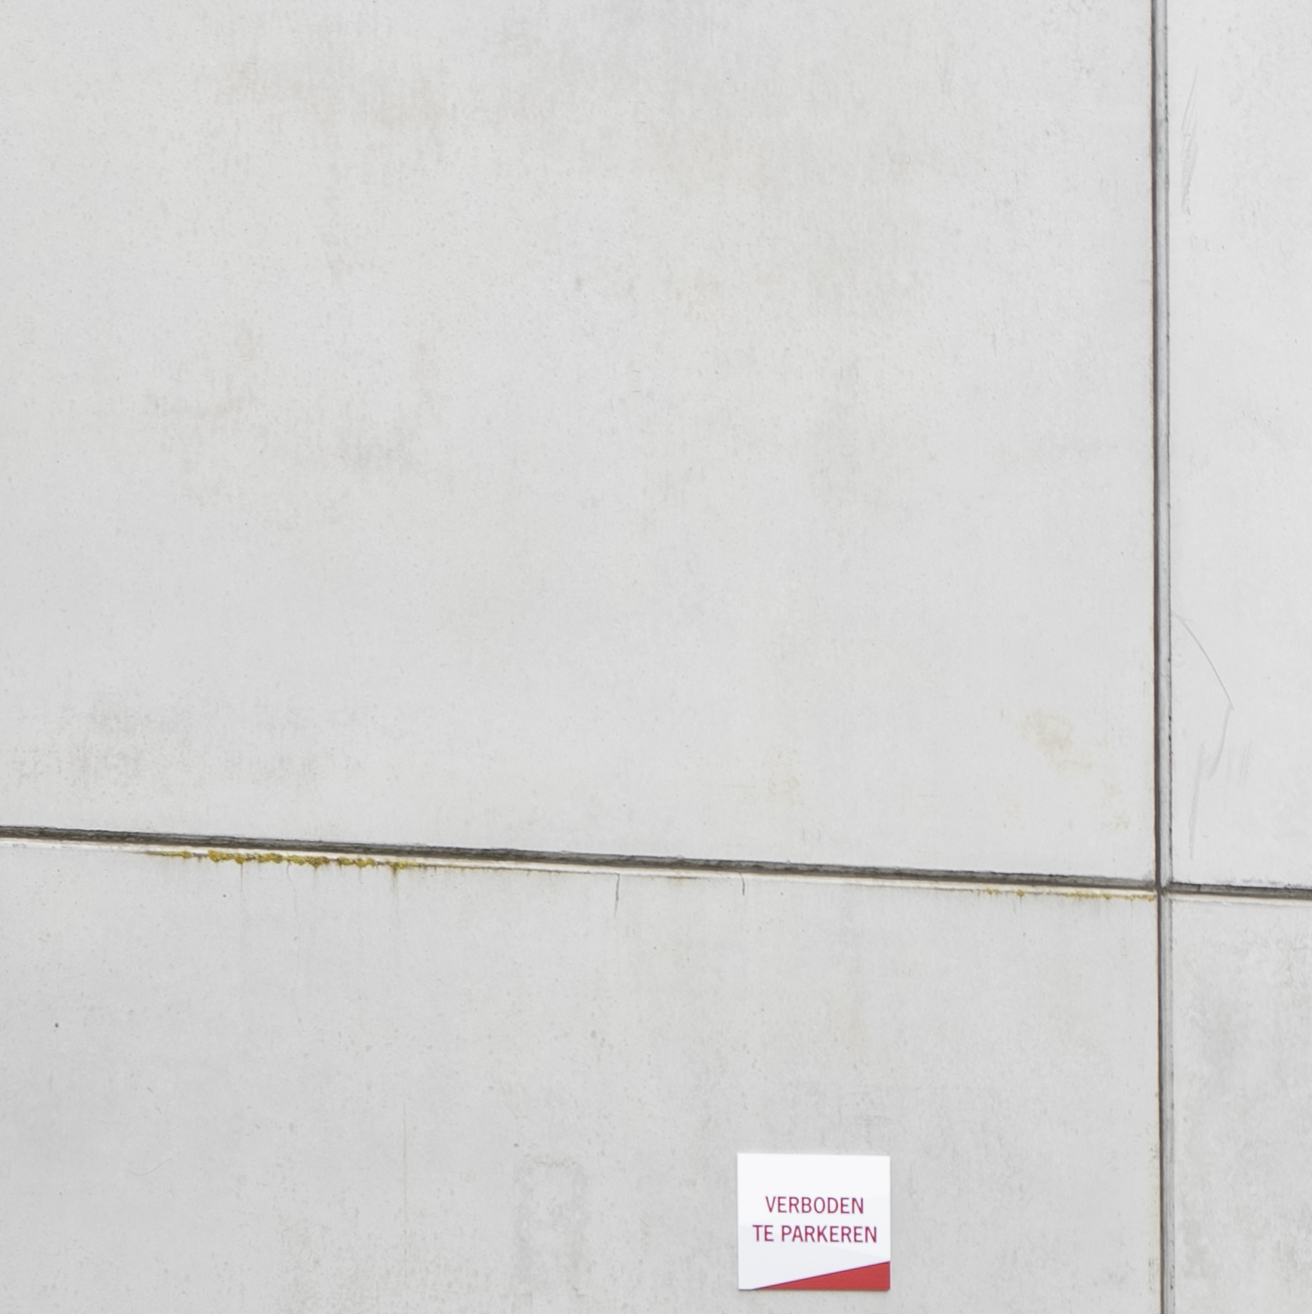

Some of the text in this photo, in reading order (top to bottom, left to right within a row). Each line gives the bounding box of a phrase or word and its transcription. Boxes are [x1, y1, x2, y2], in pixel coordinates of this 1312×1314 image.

[765, 1195, 864, 1215] VERBODEN
[752, 1224, 878, 1243] TE PARKEREN
